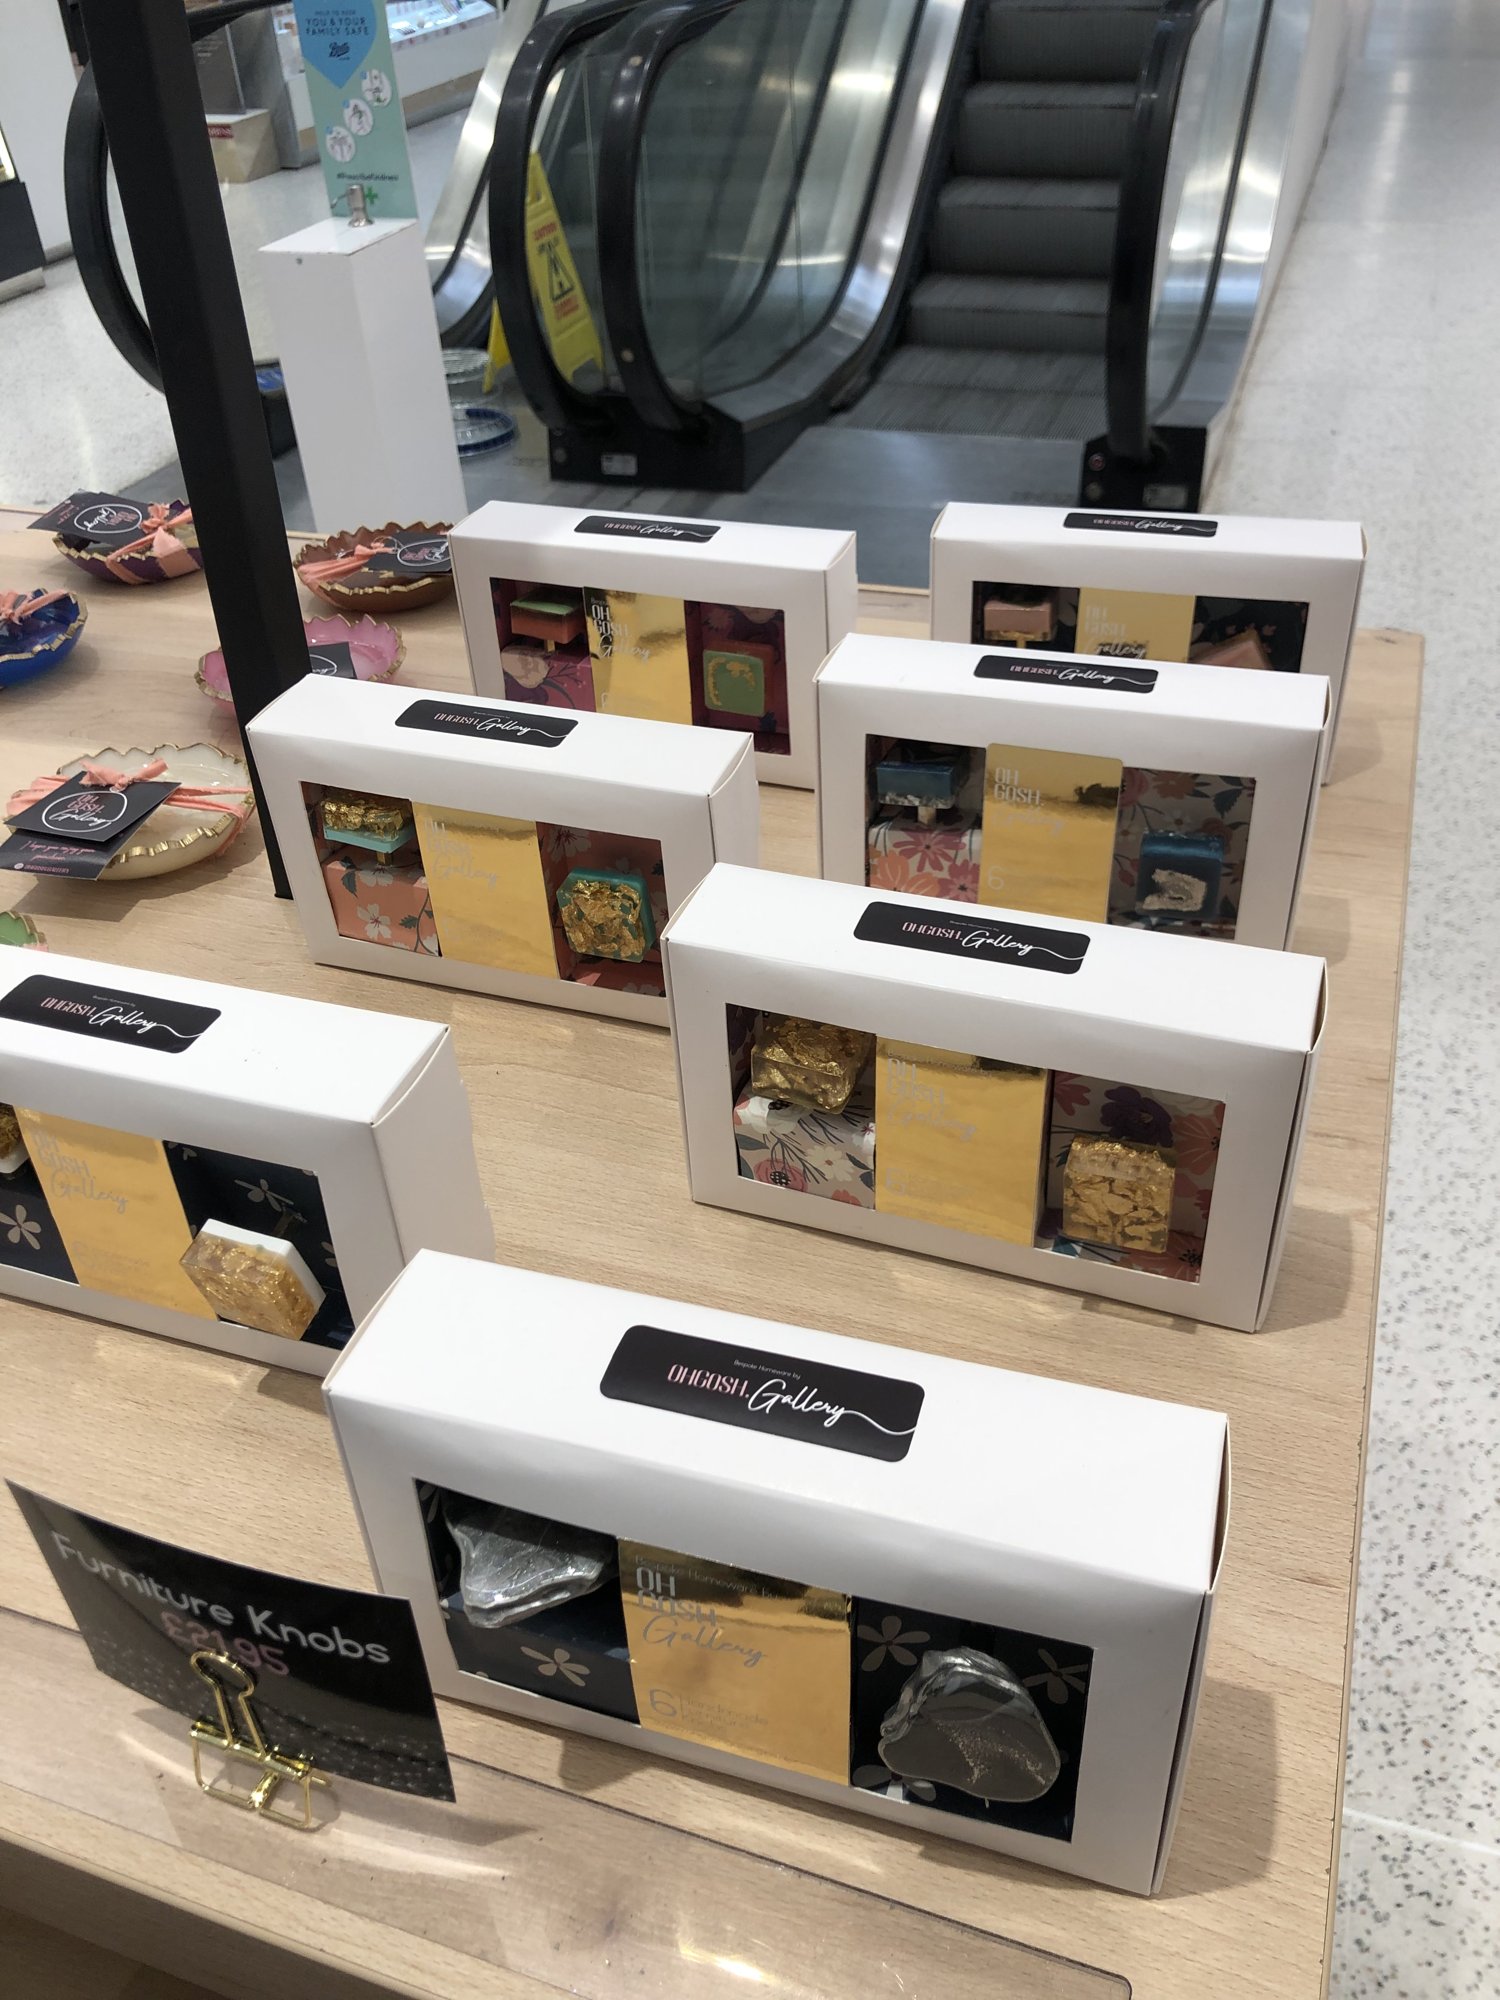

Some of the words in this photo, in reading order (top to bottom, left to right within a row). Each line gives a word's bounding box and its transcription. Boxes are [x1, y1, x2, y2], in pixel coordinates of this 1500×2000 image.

[305, 18, 327, 27] YOU
[339, 17, 366, 26] YOUR
[305, 27, 340, 36] FAMILY
[345, 26, 369, 36] SAFE
[592, 604, 610, 620] OH
[994, 766, 1020, 786] OH
[48, 808, 112, 827] Gallery
[961, 929, 1034, 957] Gallery
[88, 1005, 157, 1034] Gallery
[747, 1378, 847, 1428] Gallery
[635, 1566, 677, 1598] OH
[51, 1530, 236, 1627] Furniture
[246, 1604, 392, 1665] Knobs
[642, 1614, 768, 1669] Gallery
[648, 1688, 678, 1718] 6
